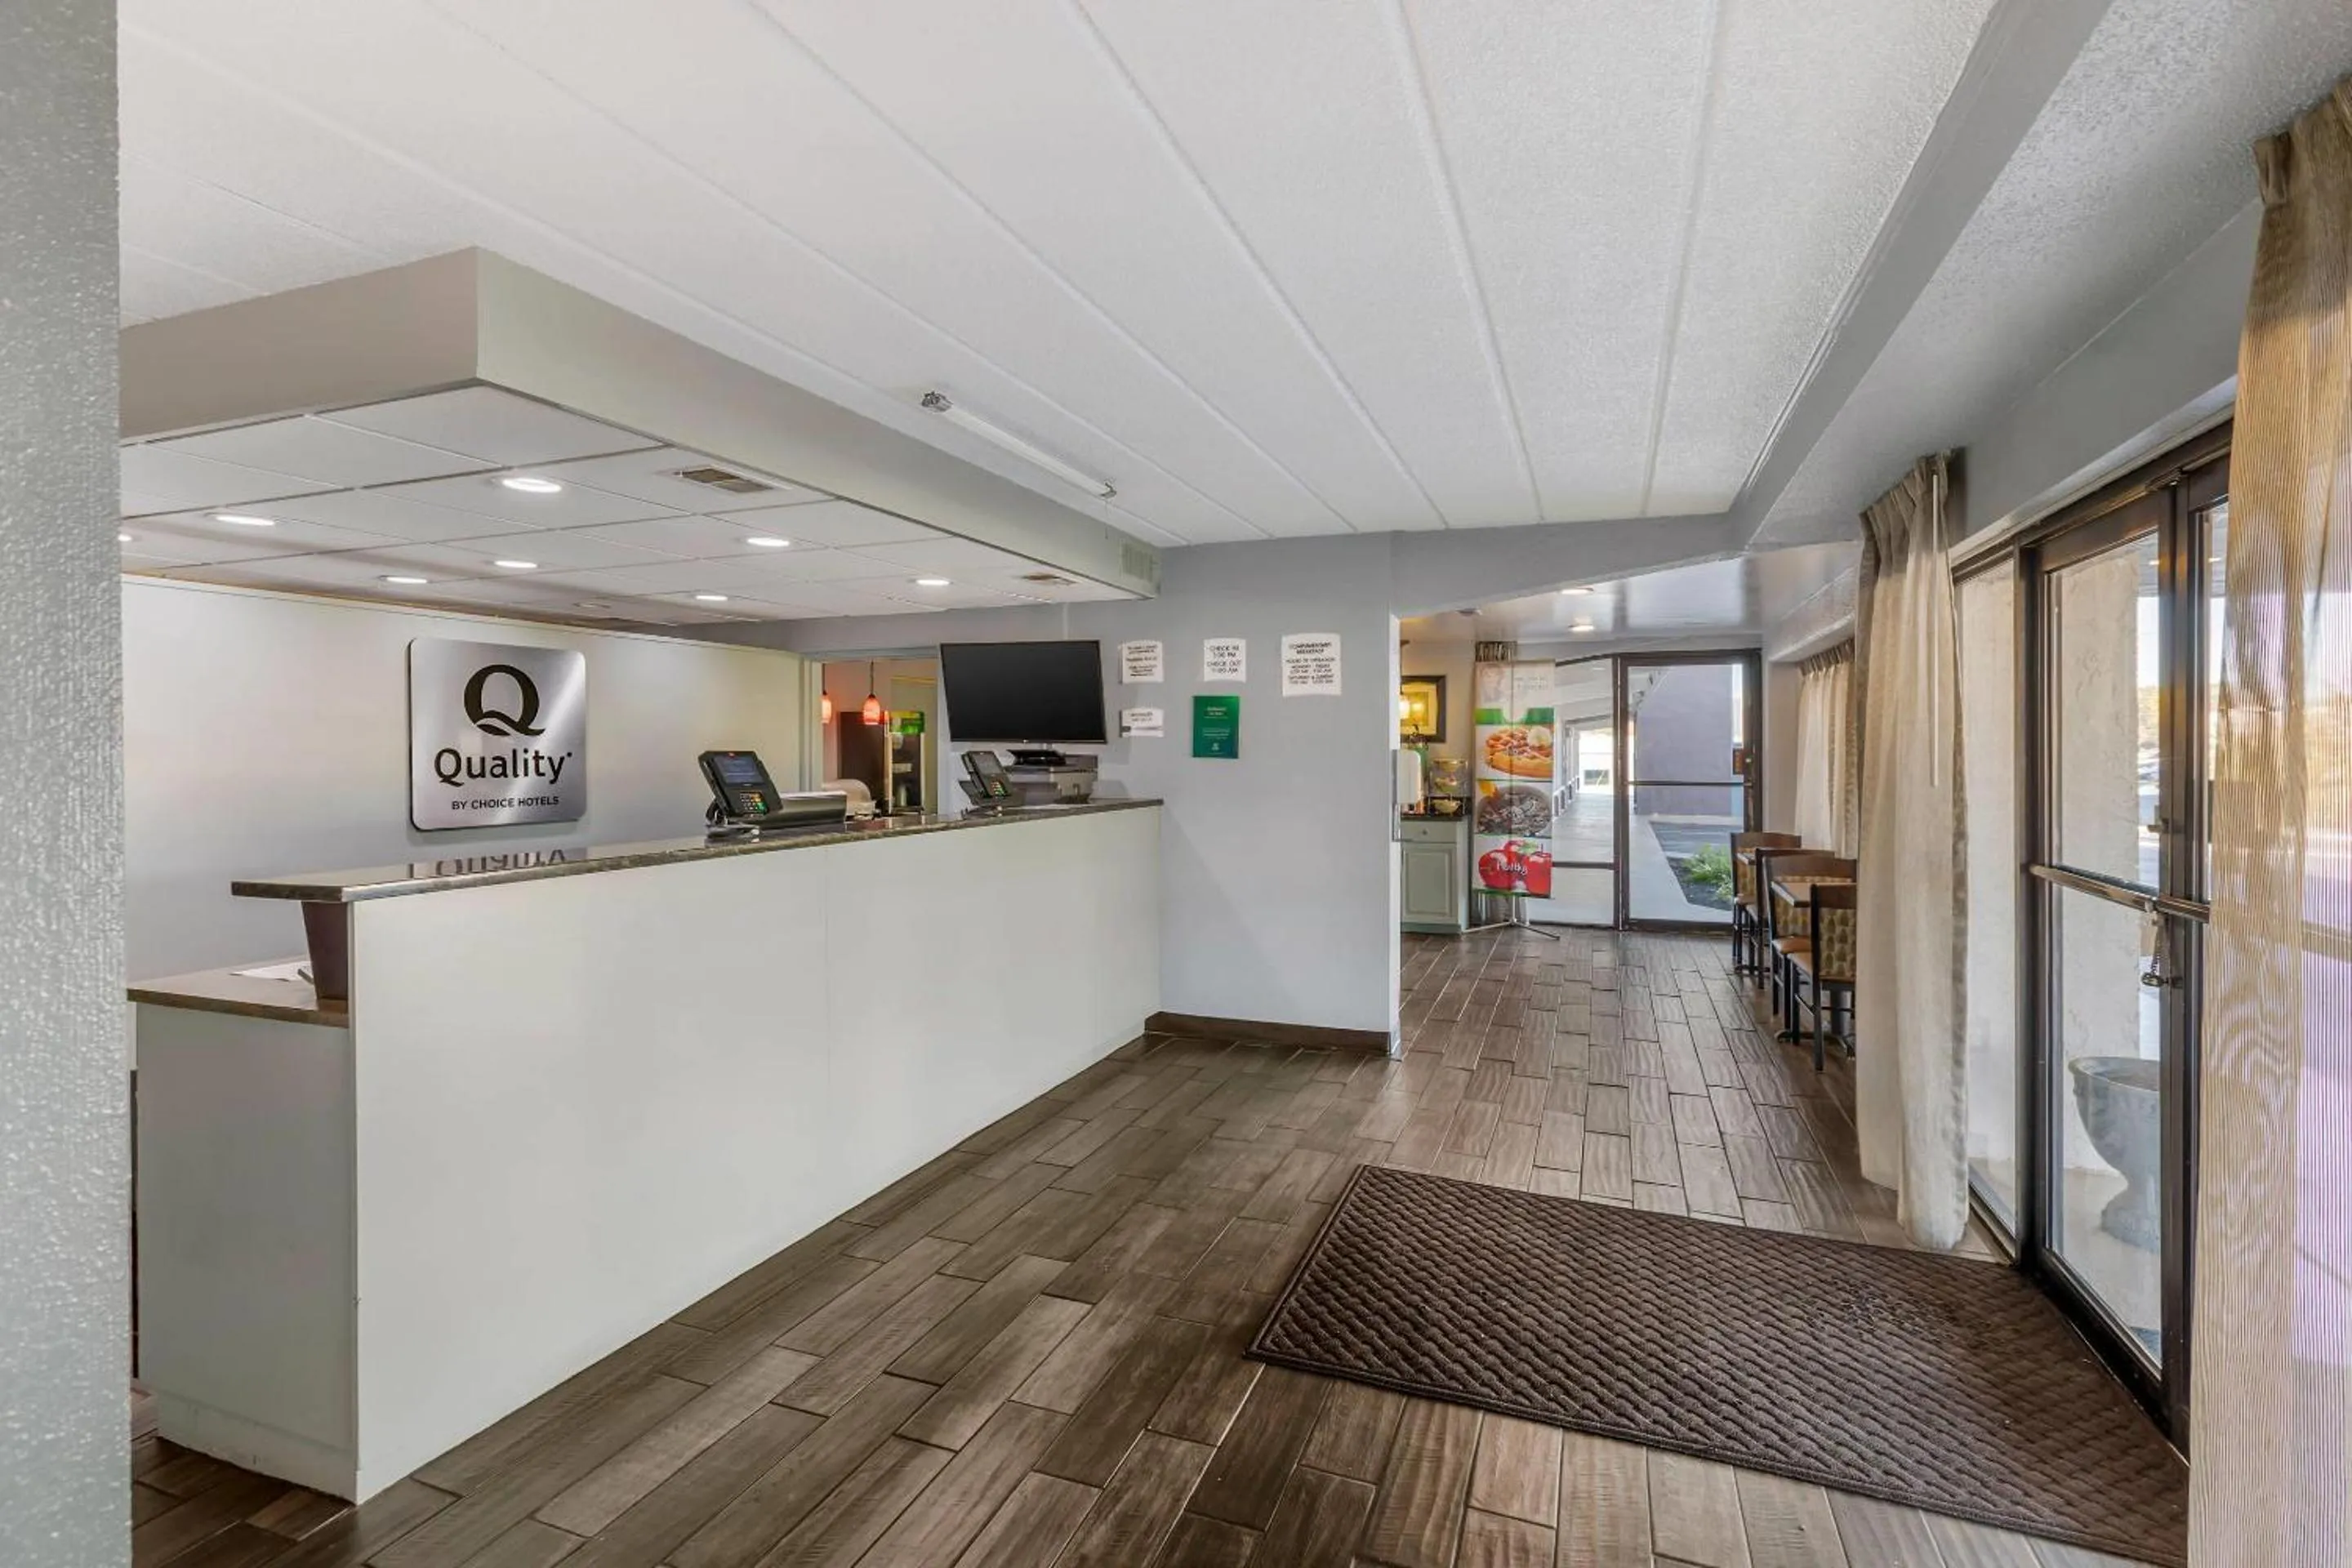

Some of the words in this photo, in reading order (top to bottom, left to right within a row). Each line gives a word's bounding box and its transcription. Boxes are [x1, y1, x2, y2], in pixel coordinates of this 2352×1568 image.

[464, 664, 546, 736] Q
[434, 748, 565, 787] Quality
[452, 800, 467, 810] BY
[471, 798, 514, 809] CHOICE
[519, 796, 559, 807] HOTELS
